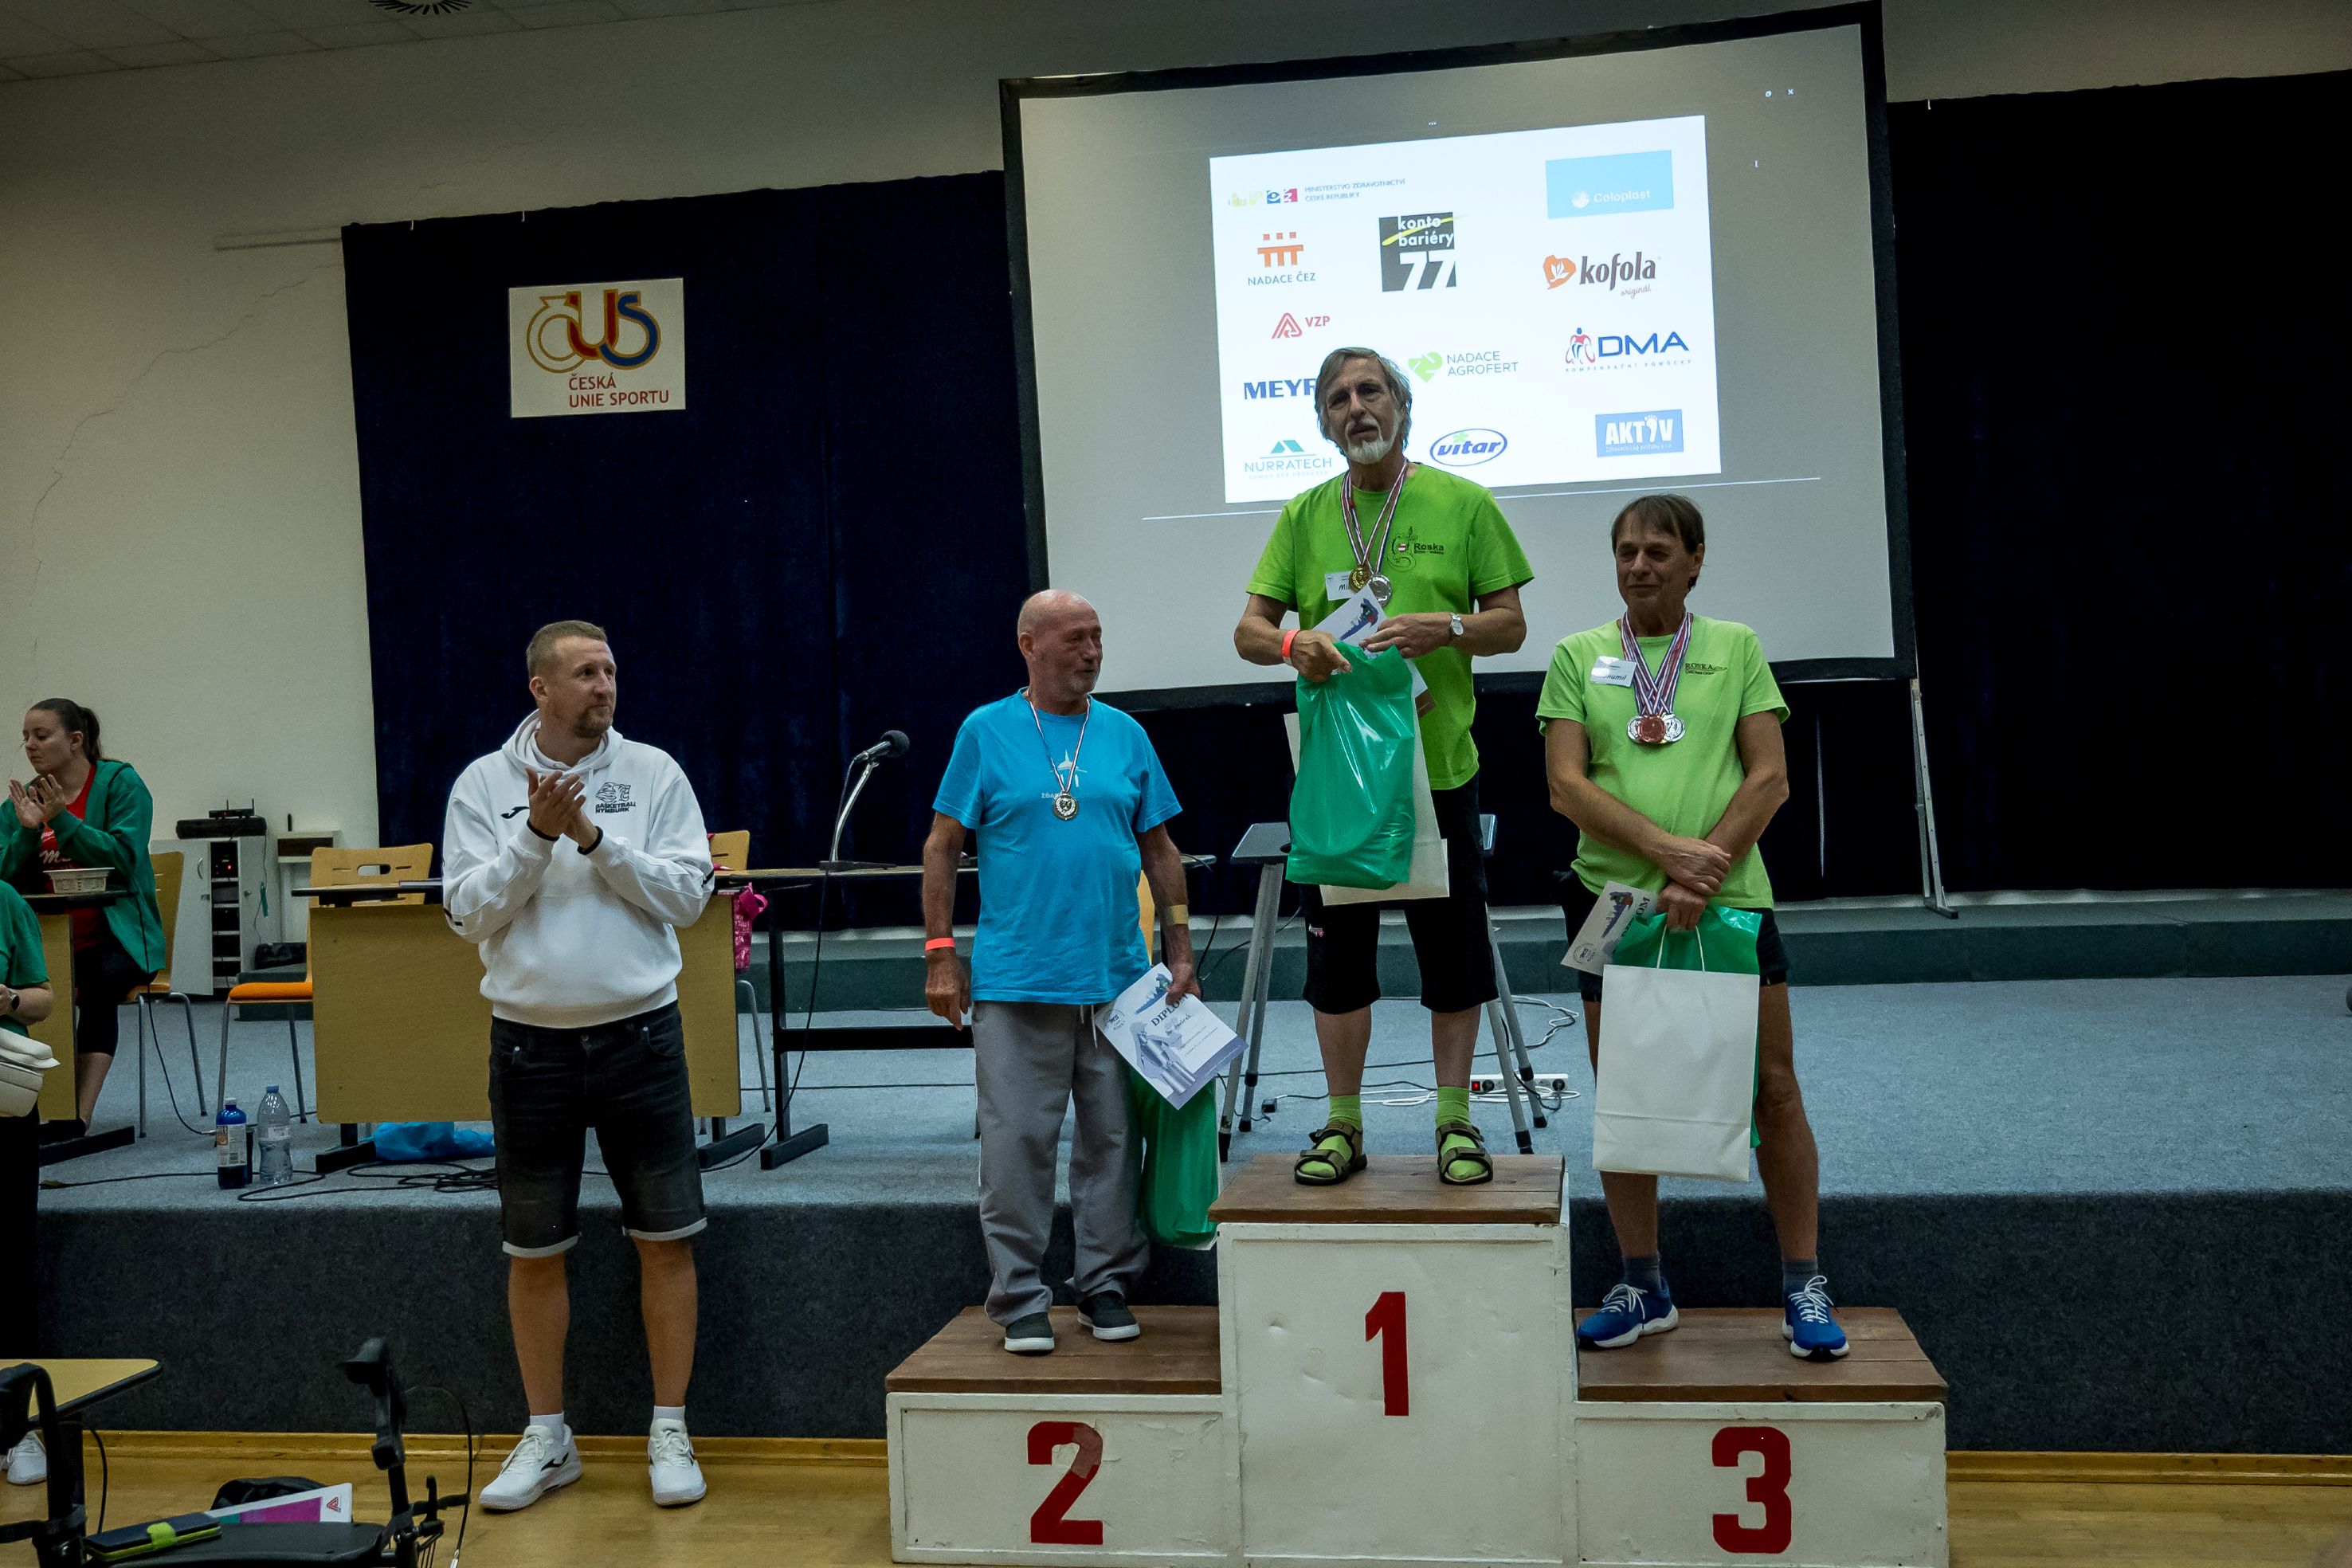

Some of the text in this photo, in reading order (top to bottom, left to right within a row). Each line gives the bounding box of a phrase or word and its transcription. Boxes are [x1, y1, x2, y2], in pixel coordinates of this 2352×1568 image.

[1305, 183, 1350, 193] MINISTERSTVO
[1326, 191, 1360, 200] REPUBLIKY
[1593, 189, 1652, 203] Coloplast
[1397, 216, 1441, 230] konto
[1398, 231, 1454, 248] bariéry
[1400, 249, 1456, 290] 77
[1579, 251, 1656, 292] kofola
[1248, 271, 1316, 286] NADACE ČEZ
[1305, 316, 1331, 327] VZP
[1597, 331, 1690, 357] DMA
[1447, 351, 1500, 364] NADACE
[1447, 362, 1519, 377] AGROFERT
[568, 372, 617, 390] ČESKÁ
[1244, 378, 1316, 400] MEYR
[569, 390, 669, 408] UNIE SPORTU
[1437, 441, 1502, 456] vitar
[1245, 457, 1332, 472] NURRATECH
[1413, 543, 1445, 551] Roska
[1364, 1291, 1409, 1417] 1
[1027, 1421, 1104, 1545] 2
[1711, 1426, 1792, 1554] 3
